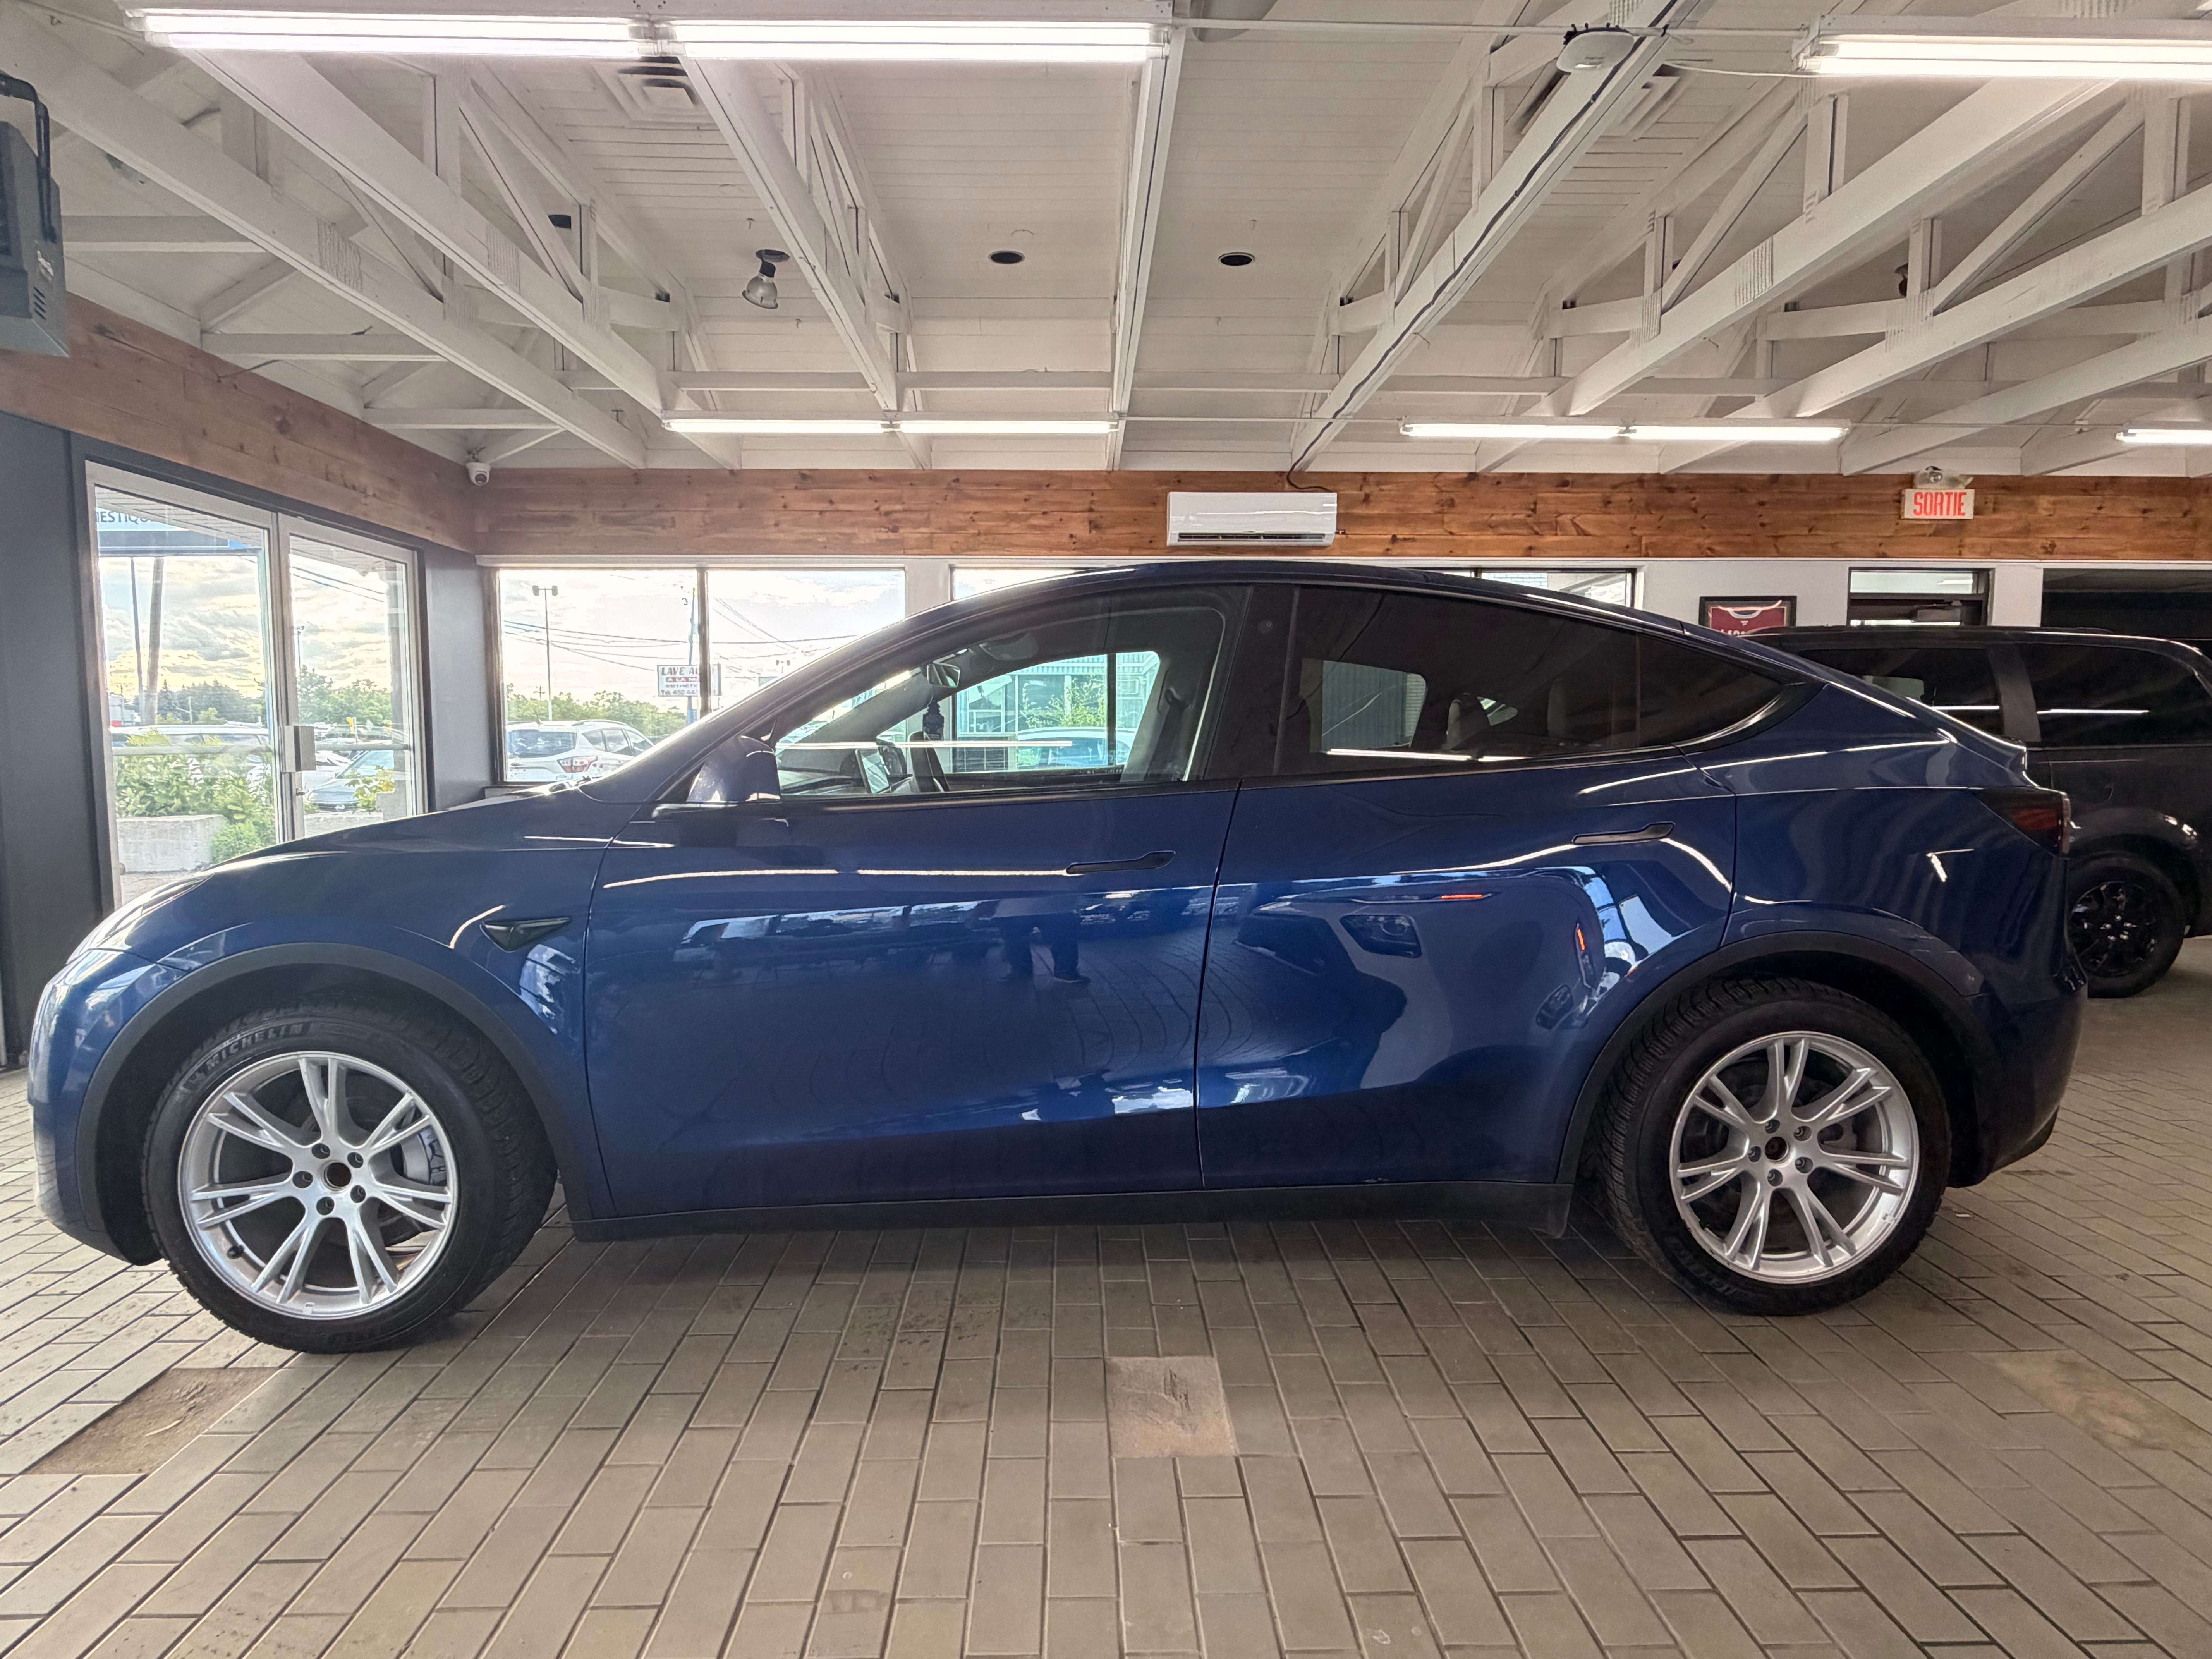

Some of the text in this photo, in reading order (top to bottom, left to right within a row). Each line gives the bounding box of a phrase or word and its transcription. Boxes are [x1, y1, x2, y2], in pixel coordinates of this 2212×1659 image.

[1913, 491, 1967, 516] SORTIE
[97, 511, 151, 525] ESTIQ
[661, 667, 685, 675] LAVE
[205, 1023, 304, 1071] MICHELIN
